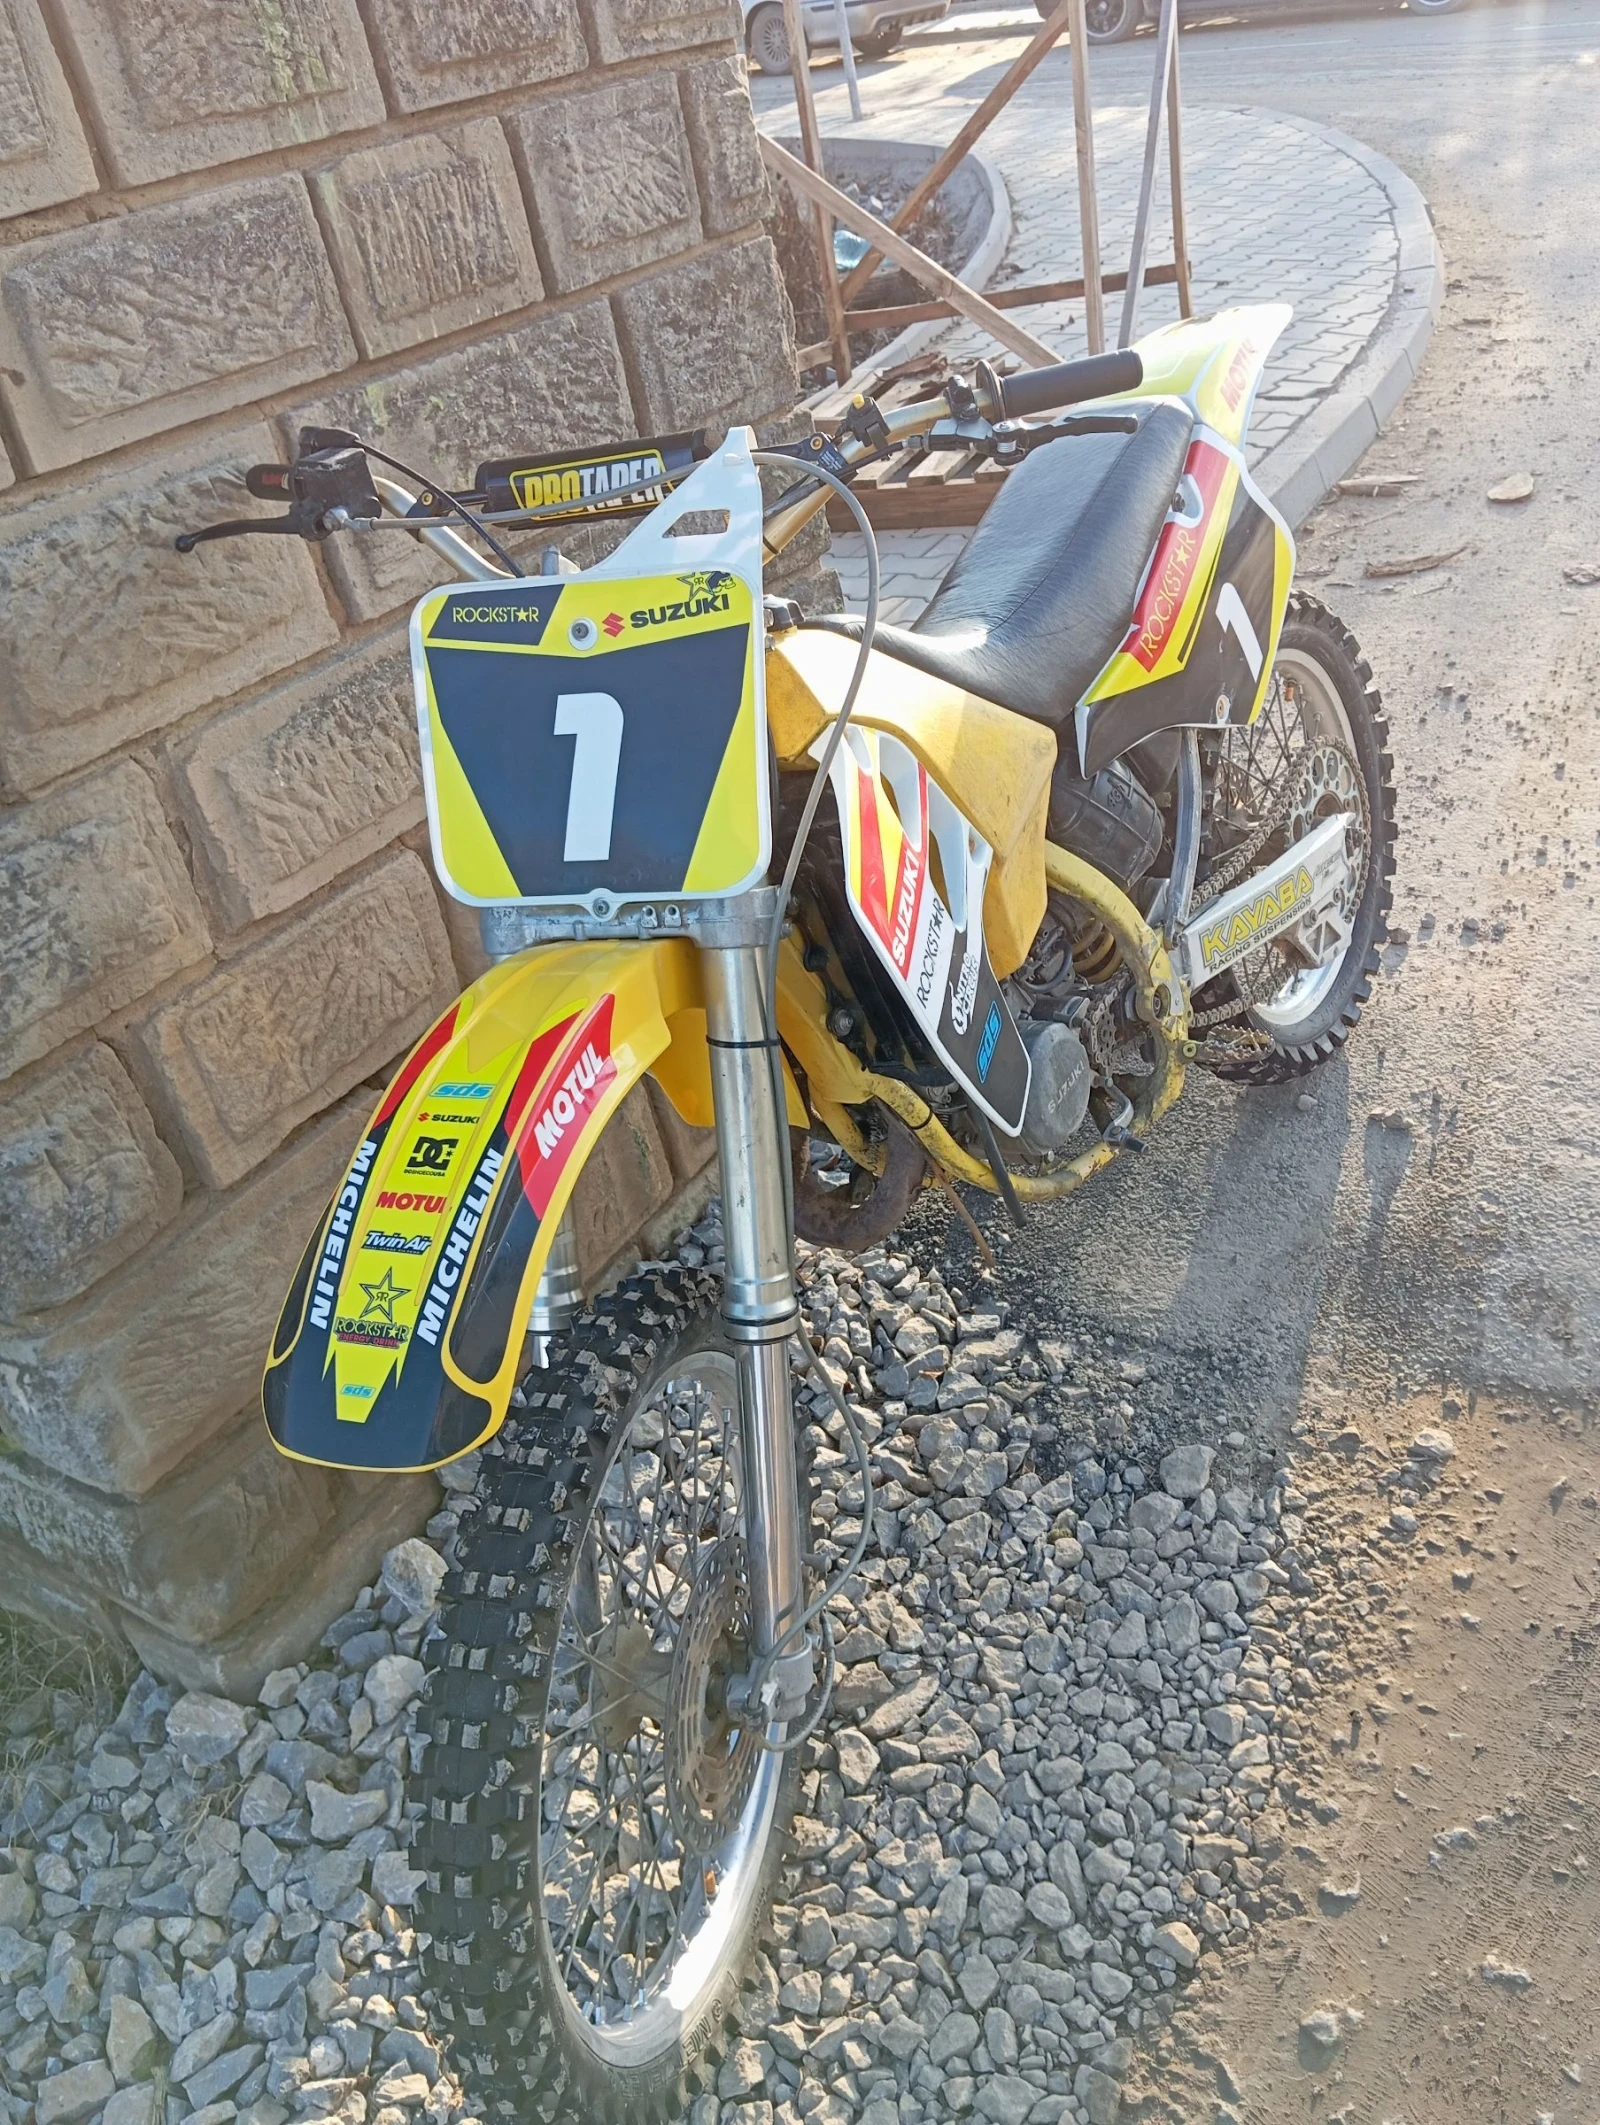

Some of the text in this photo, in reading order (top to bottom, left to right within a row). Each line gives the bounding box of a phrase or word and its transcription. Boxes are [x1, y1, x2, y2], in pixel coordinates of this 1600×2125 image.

[630, 593, 730, 629] SUZUKI
[1215, 582, 1264, 683] 1
[553, 691, 625, 862] 1
[892, 849, 920, 967] SUZUKI
[1200, 867, 1313, 966] KAYABA
[1209, 896, 1312, 973] RACING SUSPENSION
[431, 1113, 481, 1124] SUZUKI
[433, 1082, 495, 1098] sds
[533, 1041, 605, 1160] MOTUL
[1047, 1060, 1085, 1114] SUZUKI
[310, 1140, 378, 1330] MICHELIN
[364, 1231, 406, 1249] Twin
[404, 1235, 433, 1252] Air
[416, 1147, 503, 1346] MICHELIN
[338, 1332, 400, 1348] ENERGY DRINK
[616, 2015, 713, 2097] METZELER
